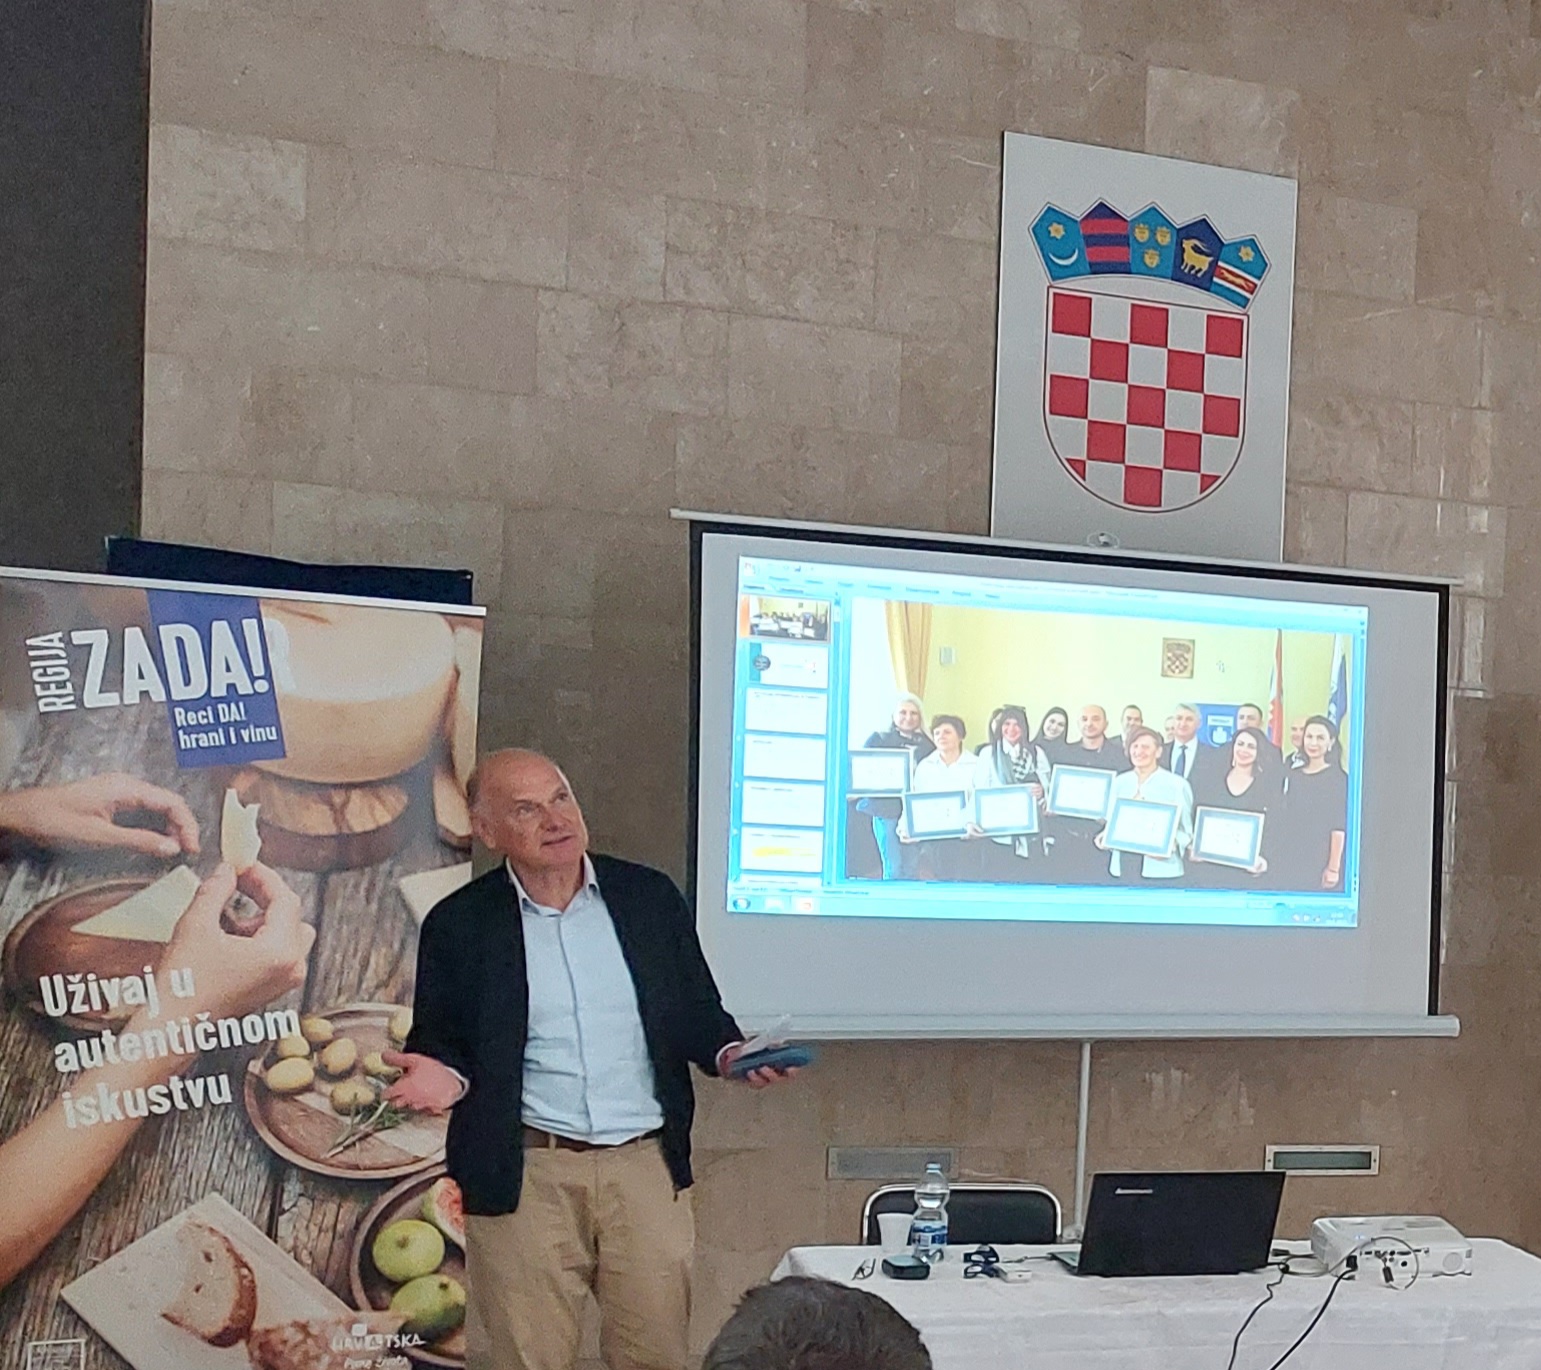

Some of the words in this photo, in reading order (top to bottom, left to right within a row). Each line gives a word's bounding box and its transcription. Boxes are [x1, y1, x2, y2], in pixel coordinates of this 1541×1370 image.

[25, 631, 77, 713] REGIJA
[174, 707, 215, 728] Reci
[218, 702, 247, 722] DA!
[178, 729, 226, 750] hrani
[230, 728, 238, 745] i
[240, 725, 278, 743] vinu
[39, 965, 161, 1020] Uživaj
[171, 968, 196, 999] u
[54, 1009, 302, 1074] autentičnom
[62, 1073, 233, 1129] iskustvu
